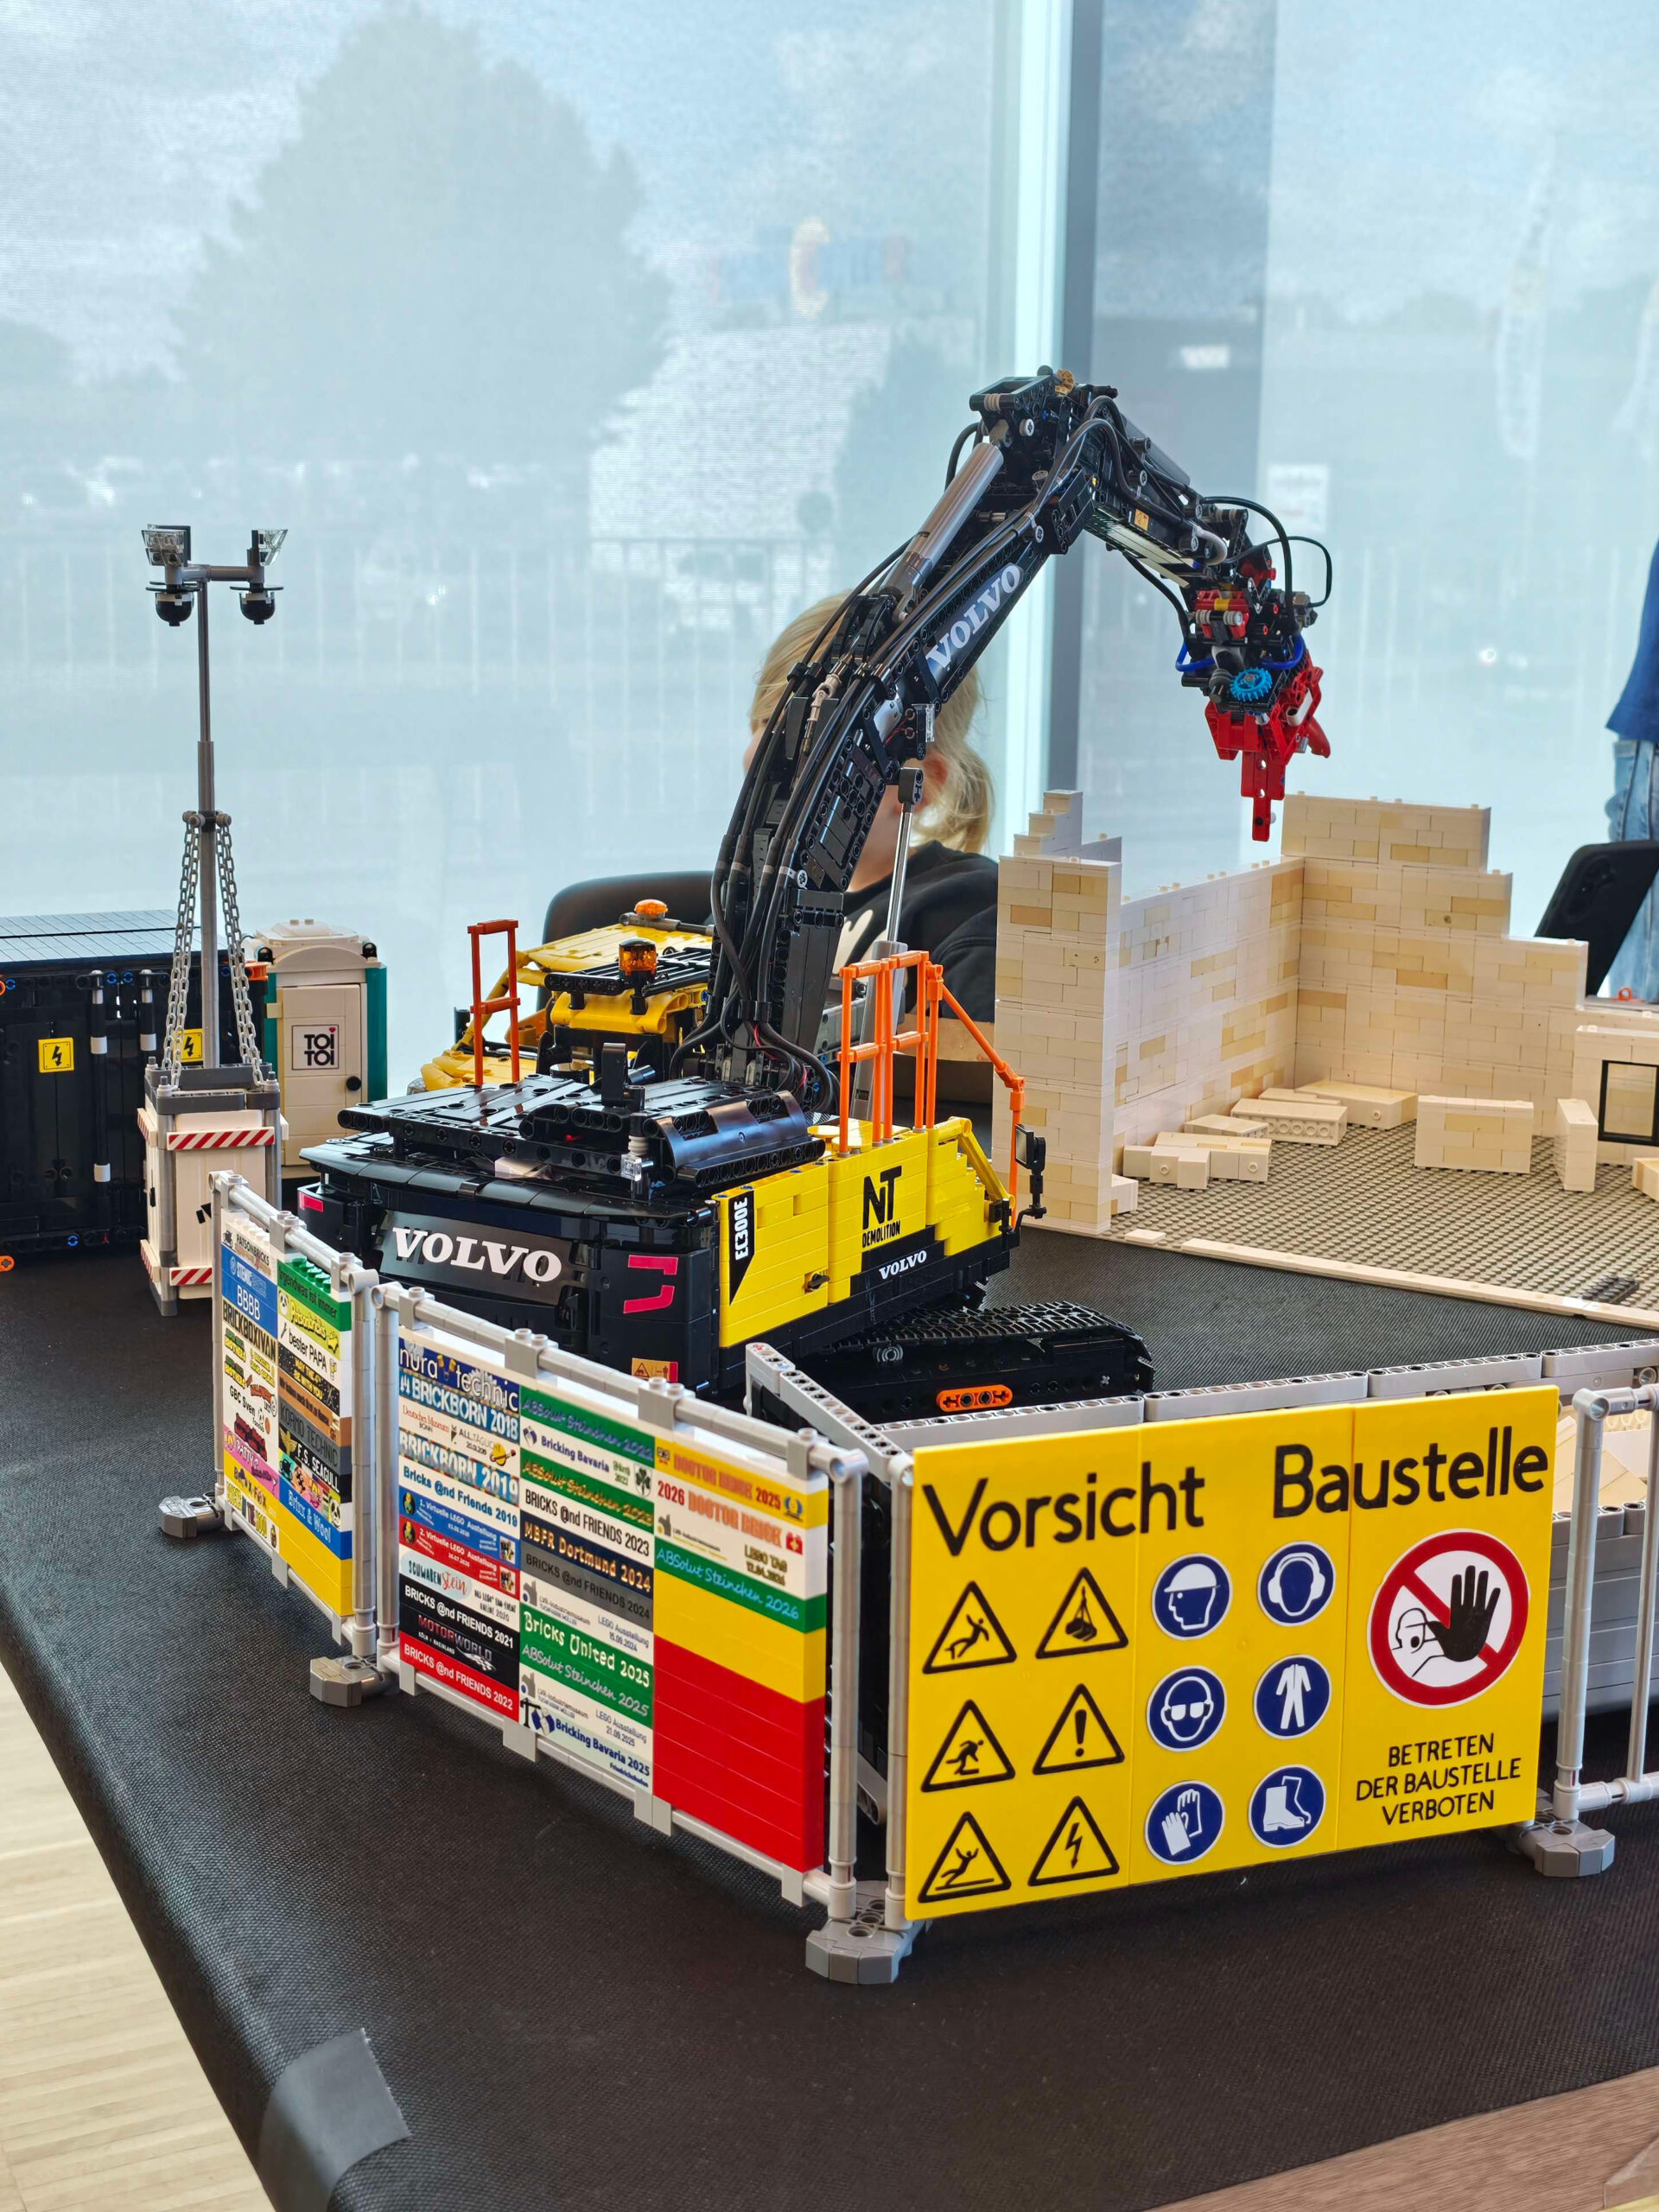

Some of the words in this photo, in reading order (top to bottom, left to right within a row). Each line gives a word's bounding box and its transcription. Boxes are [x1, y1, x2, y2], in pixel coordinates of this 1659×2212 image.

[925, 565, 1020, 669] VOLVO
[304, 1050, 335, 1066] TOI
[862, 1165, 904, 1230] NT
[734, 1197, 749, 1261] EC300E
[862, 1220, 901, 1249] DEMOLITION
[392, 1227, 563, 1282] VOLVO
[879, 1250, 928, 1280] VOLVO
[238, 1284, 260, 1320] BBBB
[289, 1328, 308, 1355] bester
[309, 1344, 327, 1373] PAPA
[230, 1386, 241, 1404] GBC
[243, 1396, 256, 1416] Sven
[400, 1348, 438, 1379] nura
[456, 1364, 518, 1412] technic
[412, 1377, 487, 1427] BRICKBORN
[490, 1410, 518, 1440] 2018
[307, 1426, 339, 1467] TECHNIC
[399, 1430, 477, 1480] BRICKBORN
[482, 1467, 518, 1497] 2019
[542, 1435, 575, 1461] Bricking
[577, 1451, 610, 1473] Bavaria
[312, 1457, 340, 1493] SEAGULL
[404, 1465, 432, 1488] Bricks
[435, 1480, 455, 1499] @nd
[458, 1491, 493, 1516] Friends
[496, 1508, 518, 1528] 2019
[658, 1480, 685, 1506] 2026
[922, 1461, 1205, 1558] Vorsicht
[1272, 1426, 1549, 1520] Baustelle
[755, 1487, 781, 1510] 2025
[525, 1489, 557, 1516] BRICKS
[560, 1505, 581, 1526] @nd
[583, 1514, 622, 1545] FRIENDS
[625, 1532, 650, 1557] 2023
[449, 1543, 465, 1554] LEGO
[524, 1521, 555, 1549] MBFR
[558, 1536, 616, 1577] Dortmund
[620, 1564, 651, 1592] 2024
[526, 1554, 561, 1578] BRICKS
[562, 1570, 582, 1588] @nd
[584, 1582, 626, 1608] FRIENDS
[627, 1600, 650, 1618] 2024
[657, 1548, 703, 1578] ABSolut
[705, 1568, 762, 1605] Steinchen
[765, 1594, 800, 1620] 2026
[404, 1584, 435, 1610] BRICKS
[436, 1603, 455, 1619] @nd
[456, 1611, 493, 1638] FRIENDS
[494, 1630, 513, 1649] 2021
[598, 1615, 614, 1630] LEGO
[524, 1611, 565, 1646] Bricks
[570, 1634, 615, 1670] United
[620, 1661, 651, 1688] 2025
[404, 1644, 435, 1669] BRICKS
[435, 1662, 454, 1679] @nd
[455, 1670, 492, 1699] FRIENDS
[493, 1691, 513, 1711] 2022
[596, 1709, 612, 1724] LEGO
[619, 1692, 650, 1717] 2025
[556, 1719, 591, 1748] Bricking
[593, 1737, 626, 1764] Bavaria
[627, 1756, 650, 1777] 2025
[1388, 1732, 1494, 1768] BETRETEN
[1356, 1775, 1398, 1802] DER
[1403, 1757, 1522, 1795] BAUSTELLE
[1382, 1789, 1494, 1826] VERBOTEN
